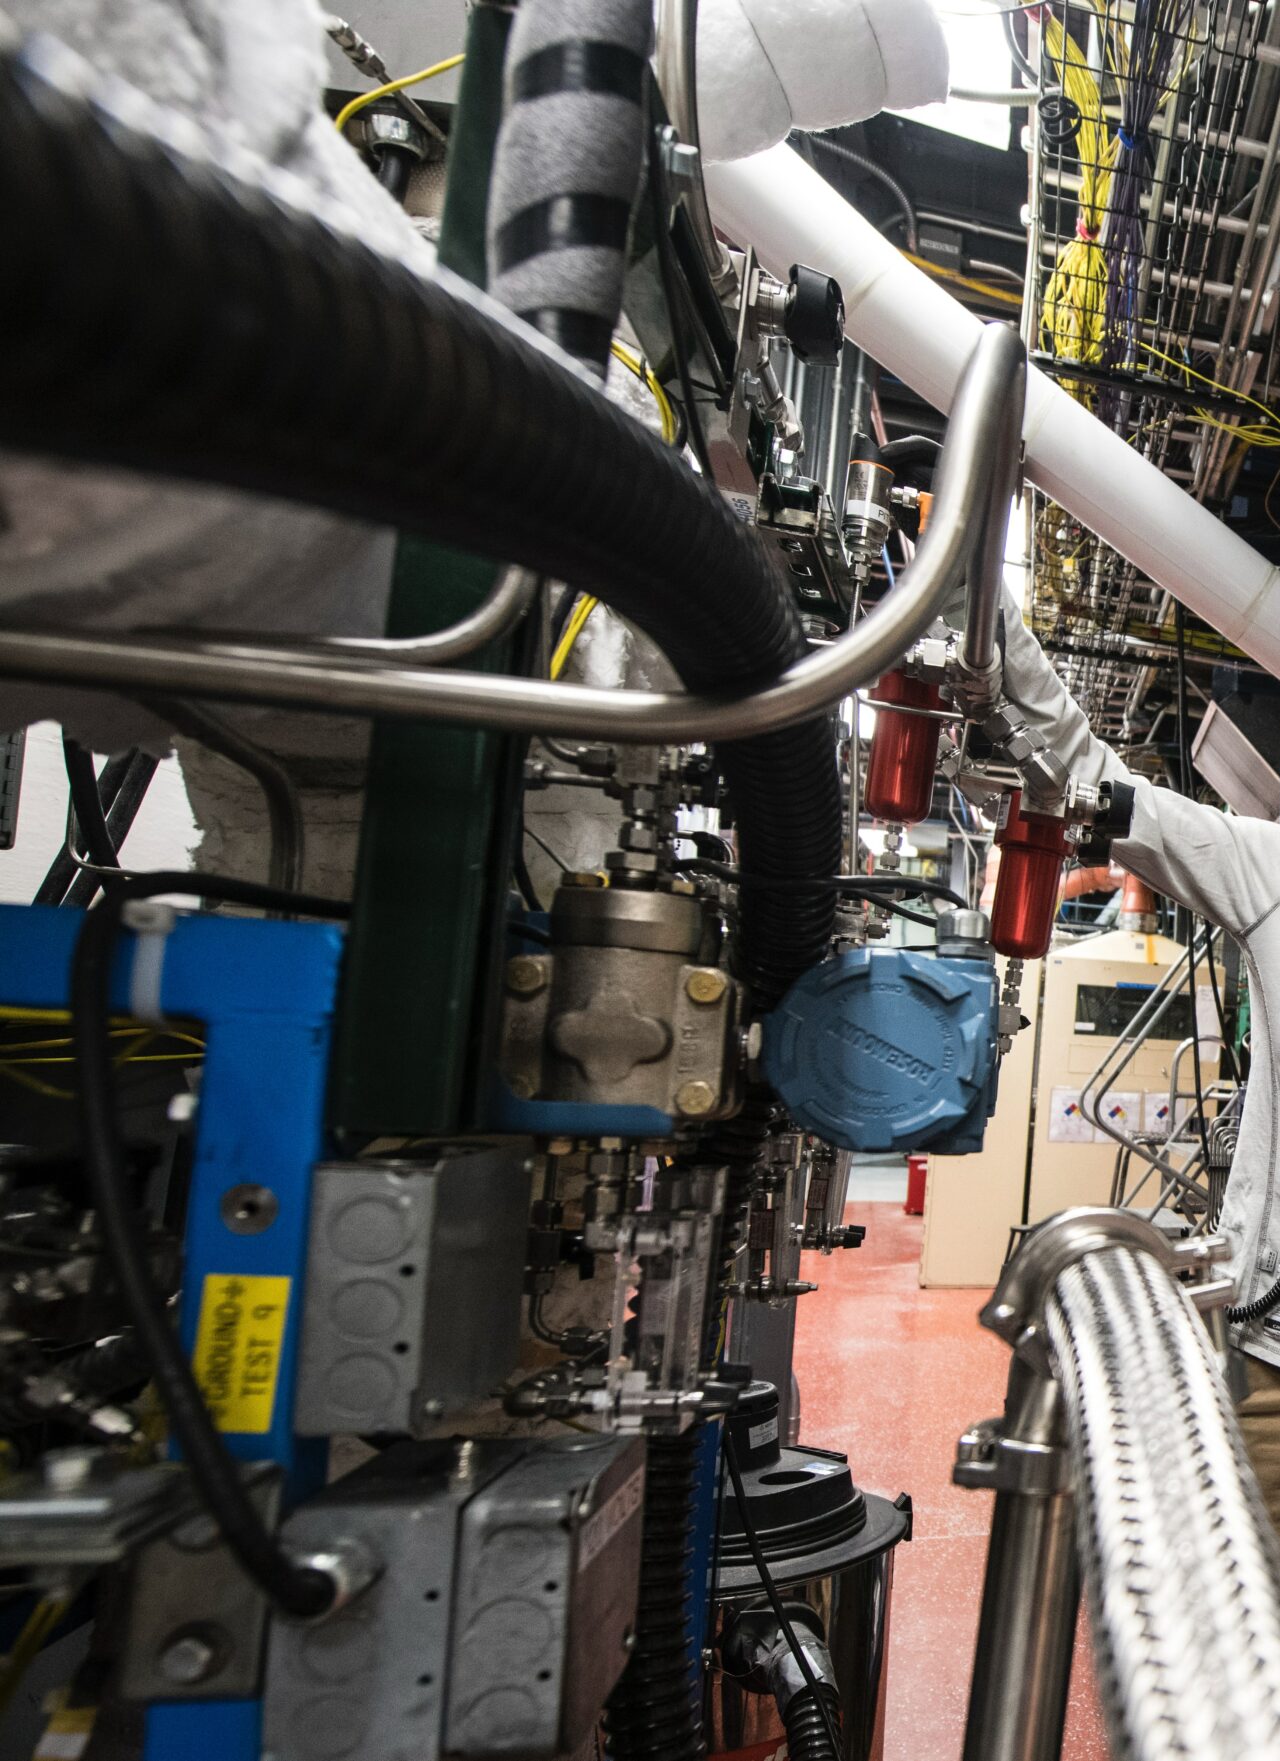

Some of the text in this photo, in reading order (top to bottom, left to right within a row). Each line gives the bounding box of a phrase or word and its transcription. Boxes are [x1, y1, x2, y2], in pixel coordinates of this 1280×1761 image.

[837, 1016, 937, 1086] ROSEMOUNT
[241, 1304, 278, 1397] TEST 9
